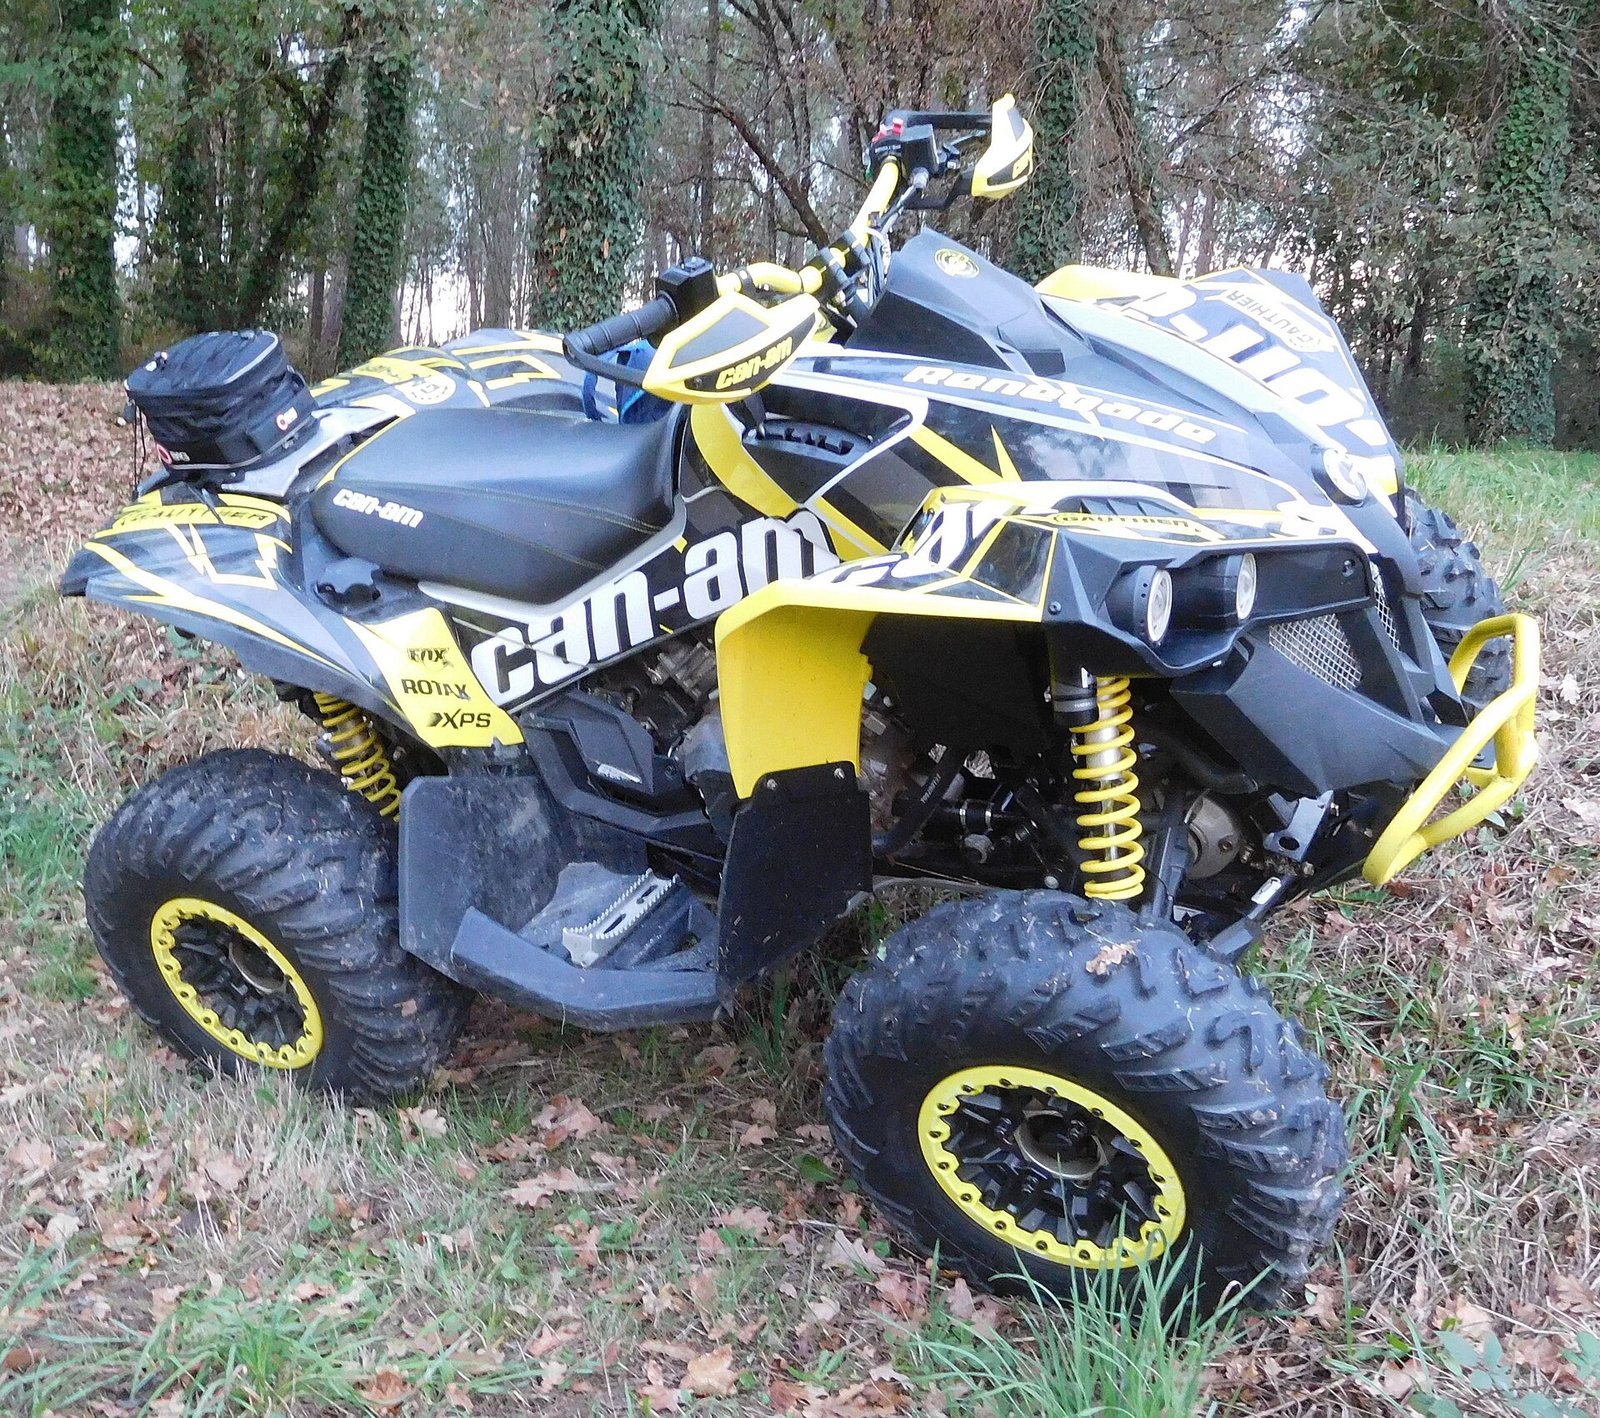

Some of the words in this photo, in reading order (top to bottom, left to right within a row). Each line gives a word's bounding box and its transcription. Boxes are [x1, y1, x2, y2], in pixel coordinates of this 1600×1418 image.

[1226, 289, 1311, 346] GAUTHIER
[714, 336, 793, 390] can-am
[903, 365, 1217, 445] Renegade
[332, 488, 424, 528] can-am
[471, 508, 840, 706] can-am
[407, 647, 450, 667] FOX
[401, 679, 470, 700] ROTAX
[440, 708, 491, 729] XPS
